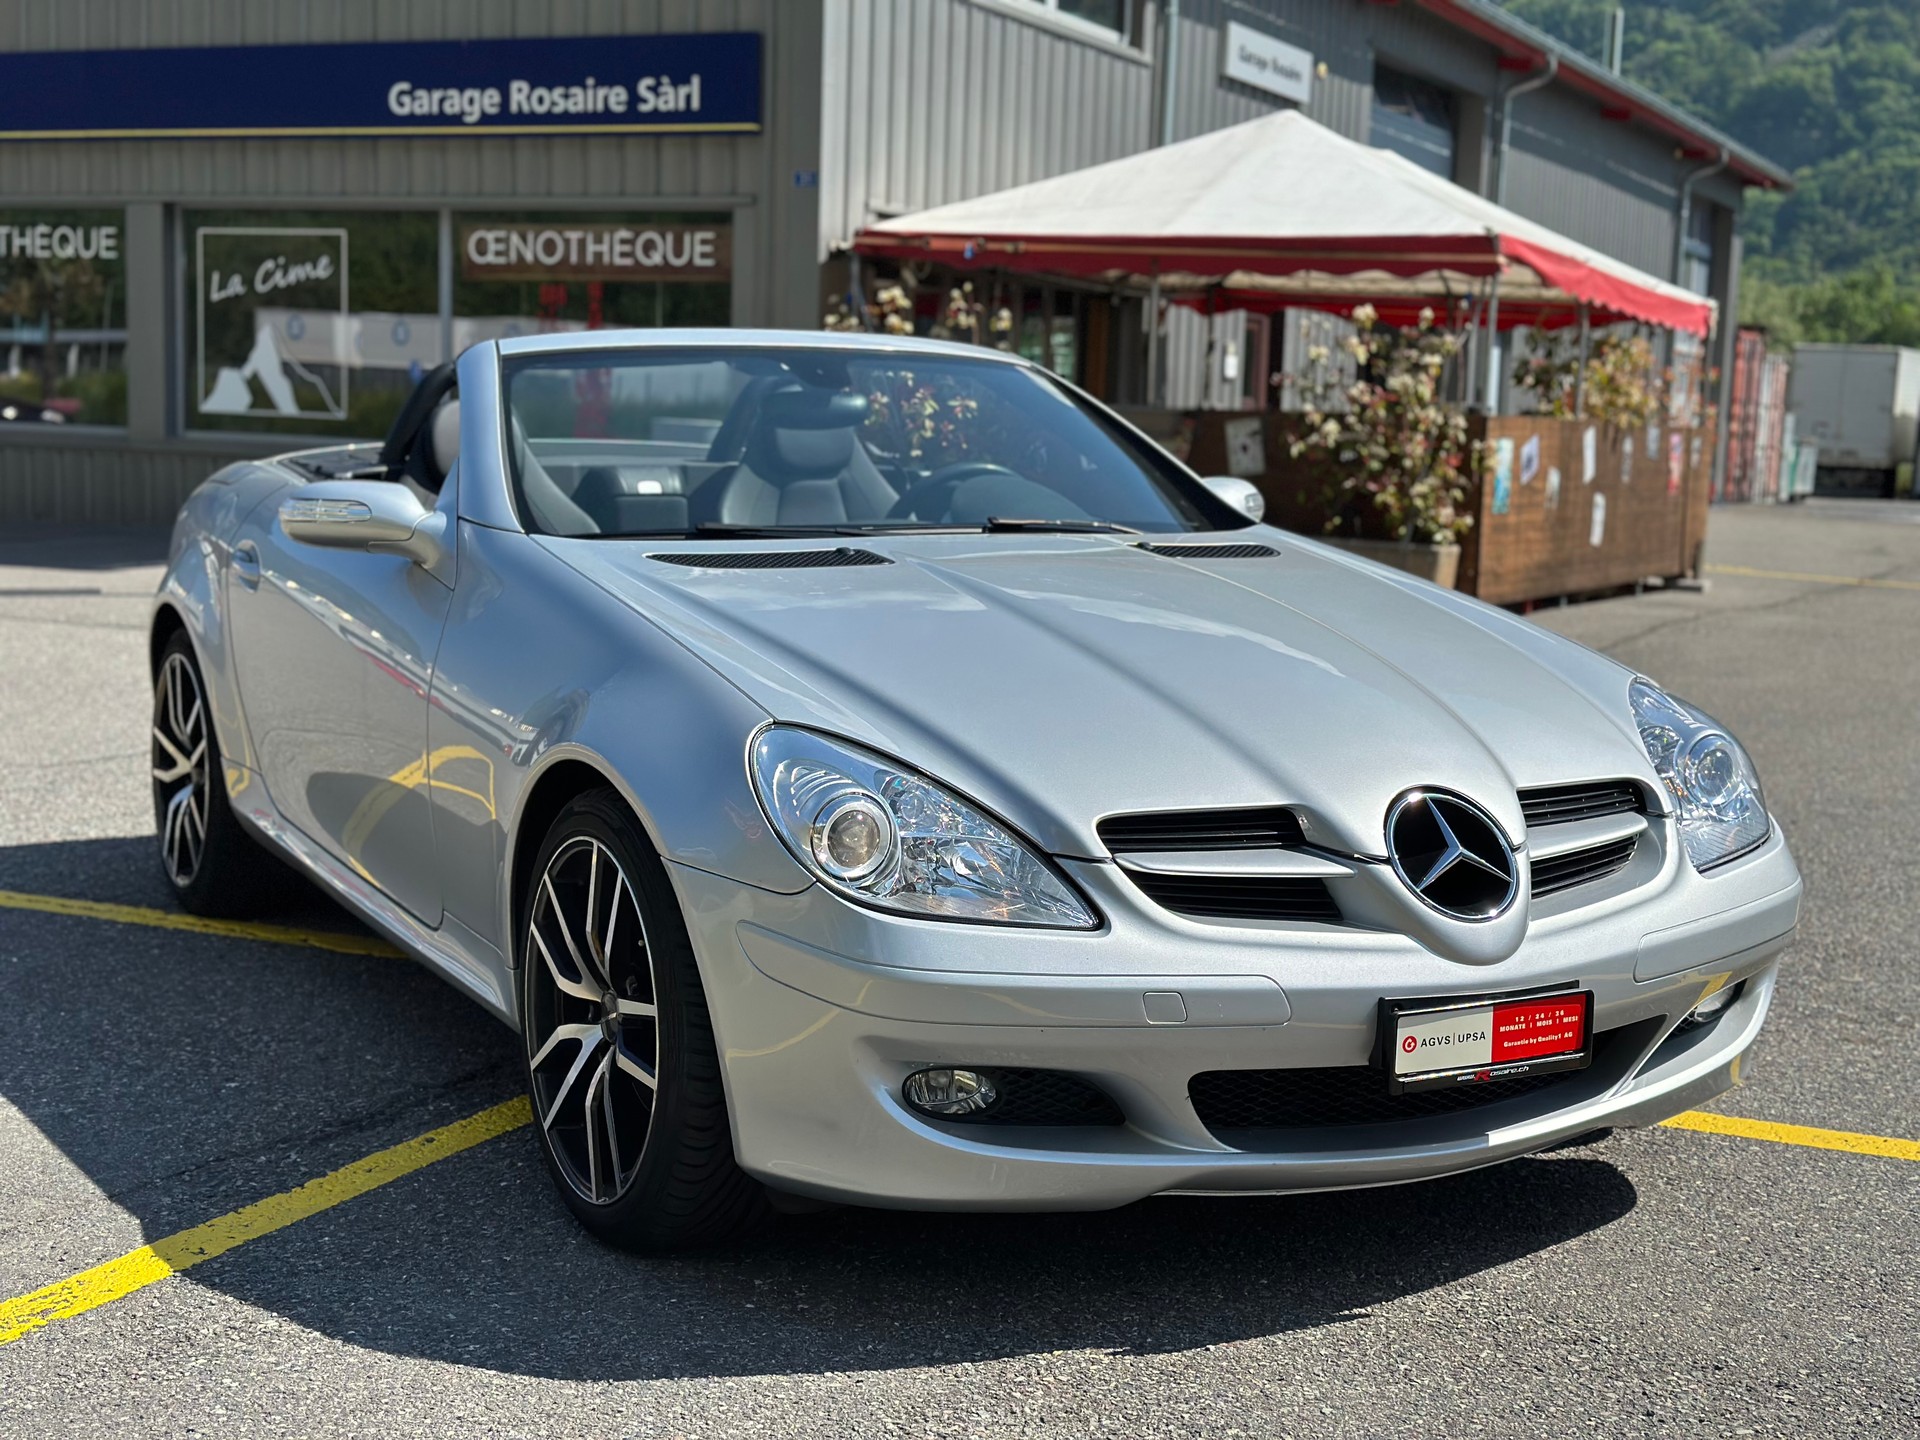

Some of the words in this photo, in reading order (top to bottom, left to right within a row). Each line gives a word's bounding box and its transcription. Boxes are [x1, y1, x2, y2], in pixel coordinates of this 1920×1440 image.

[388, 81, 501, 124] Garage
[509, 76, 629, 114] Rosaire
[636, 73, 701, 113] Sàrl
[467, 228, 717, 267] ŒNOTHÈQUE
[210, 270, 247, 303] La
[254, 254, 335, 294] Cime
[1499, 1023, 1526, 1032] MONATE
[1536, 1019, 1553, 1027] MOIS
[1515, 1015, 1525, 1023] 12
[1503, 1038, 1529, 1048] Garantie
[1563, 1031, 1573, 1039] AG
